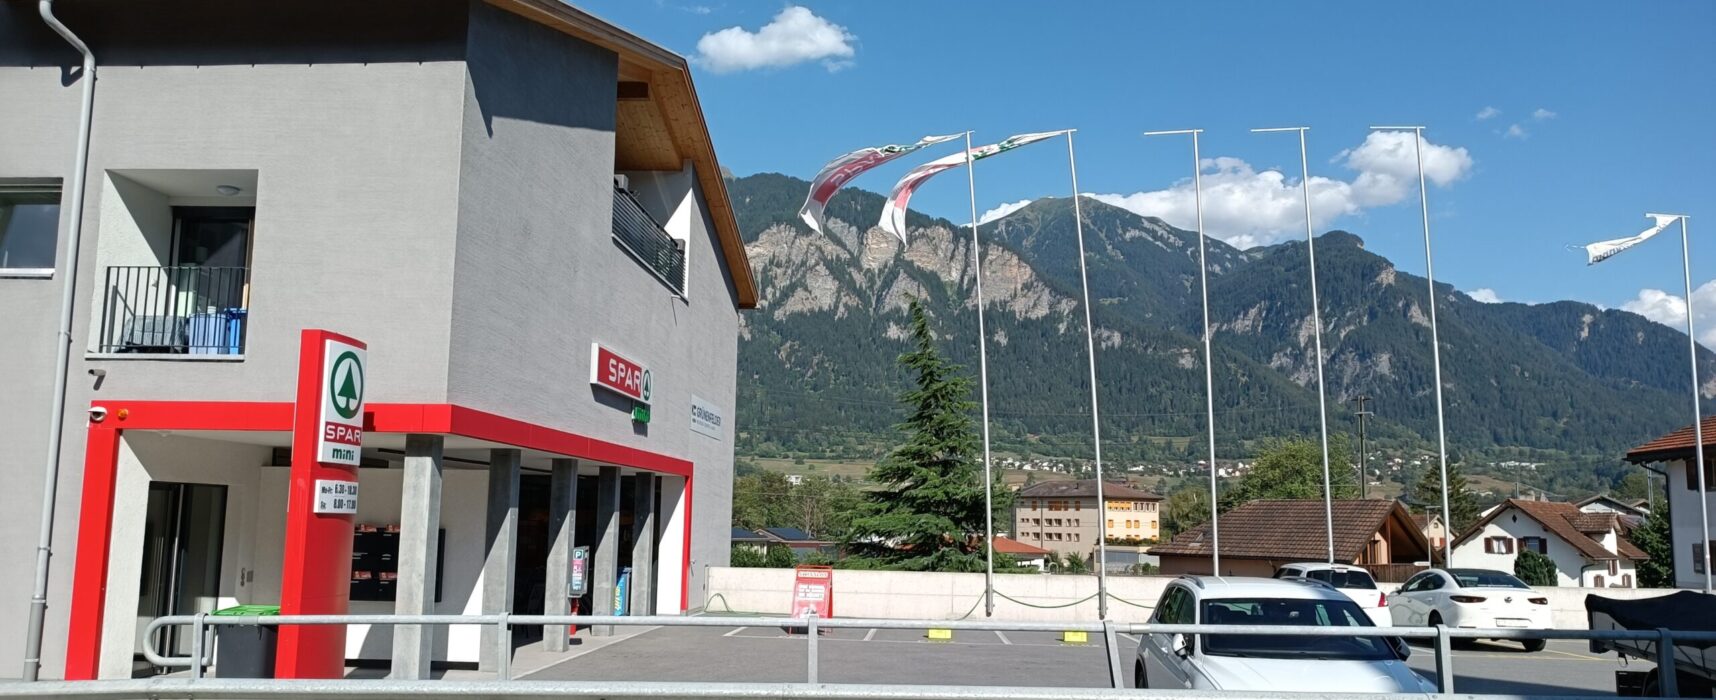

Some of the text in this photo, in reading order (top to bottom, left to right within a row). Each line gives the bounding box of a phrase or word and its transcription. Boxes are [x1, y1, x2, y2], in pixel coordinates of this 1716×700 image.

[608, 358, 641, 392] SPAR
[326, 424, 361, 443] SPAR
[332, 448, 354, 461] mini
